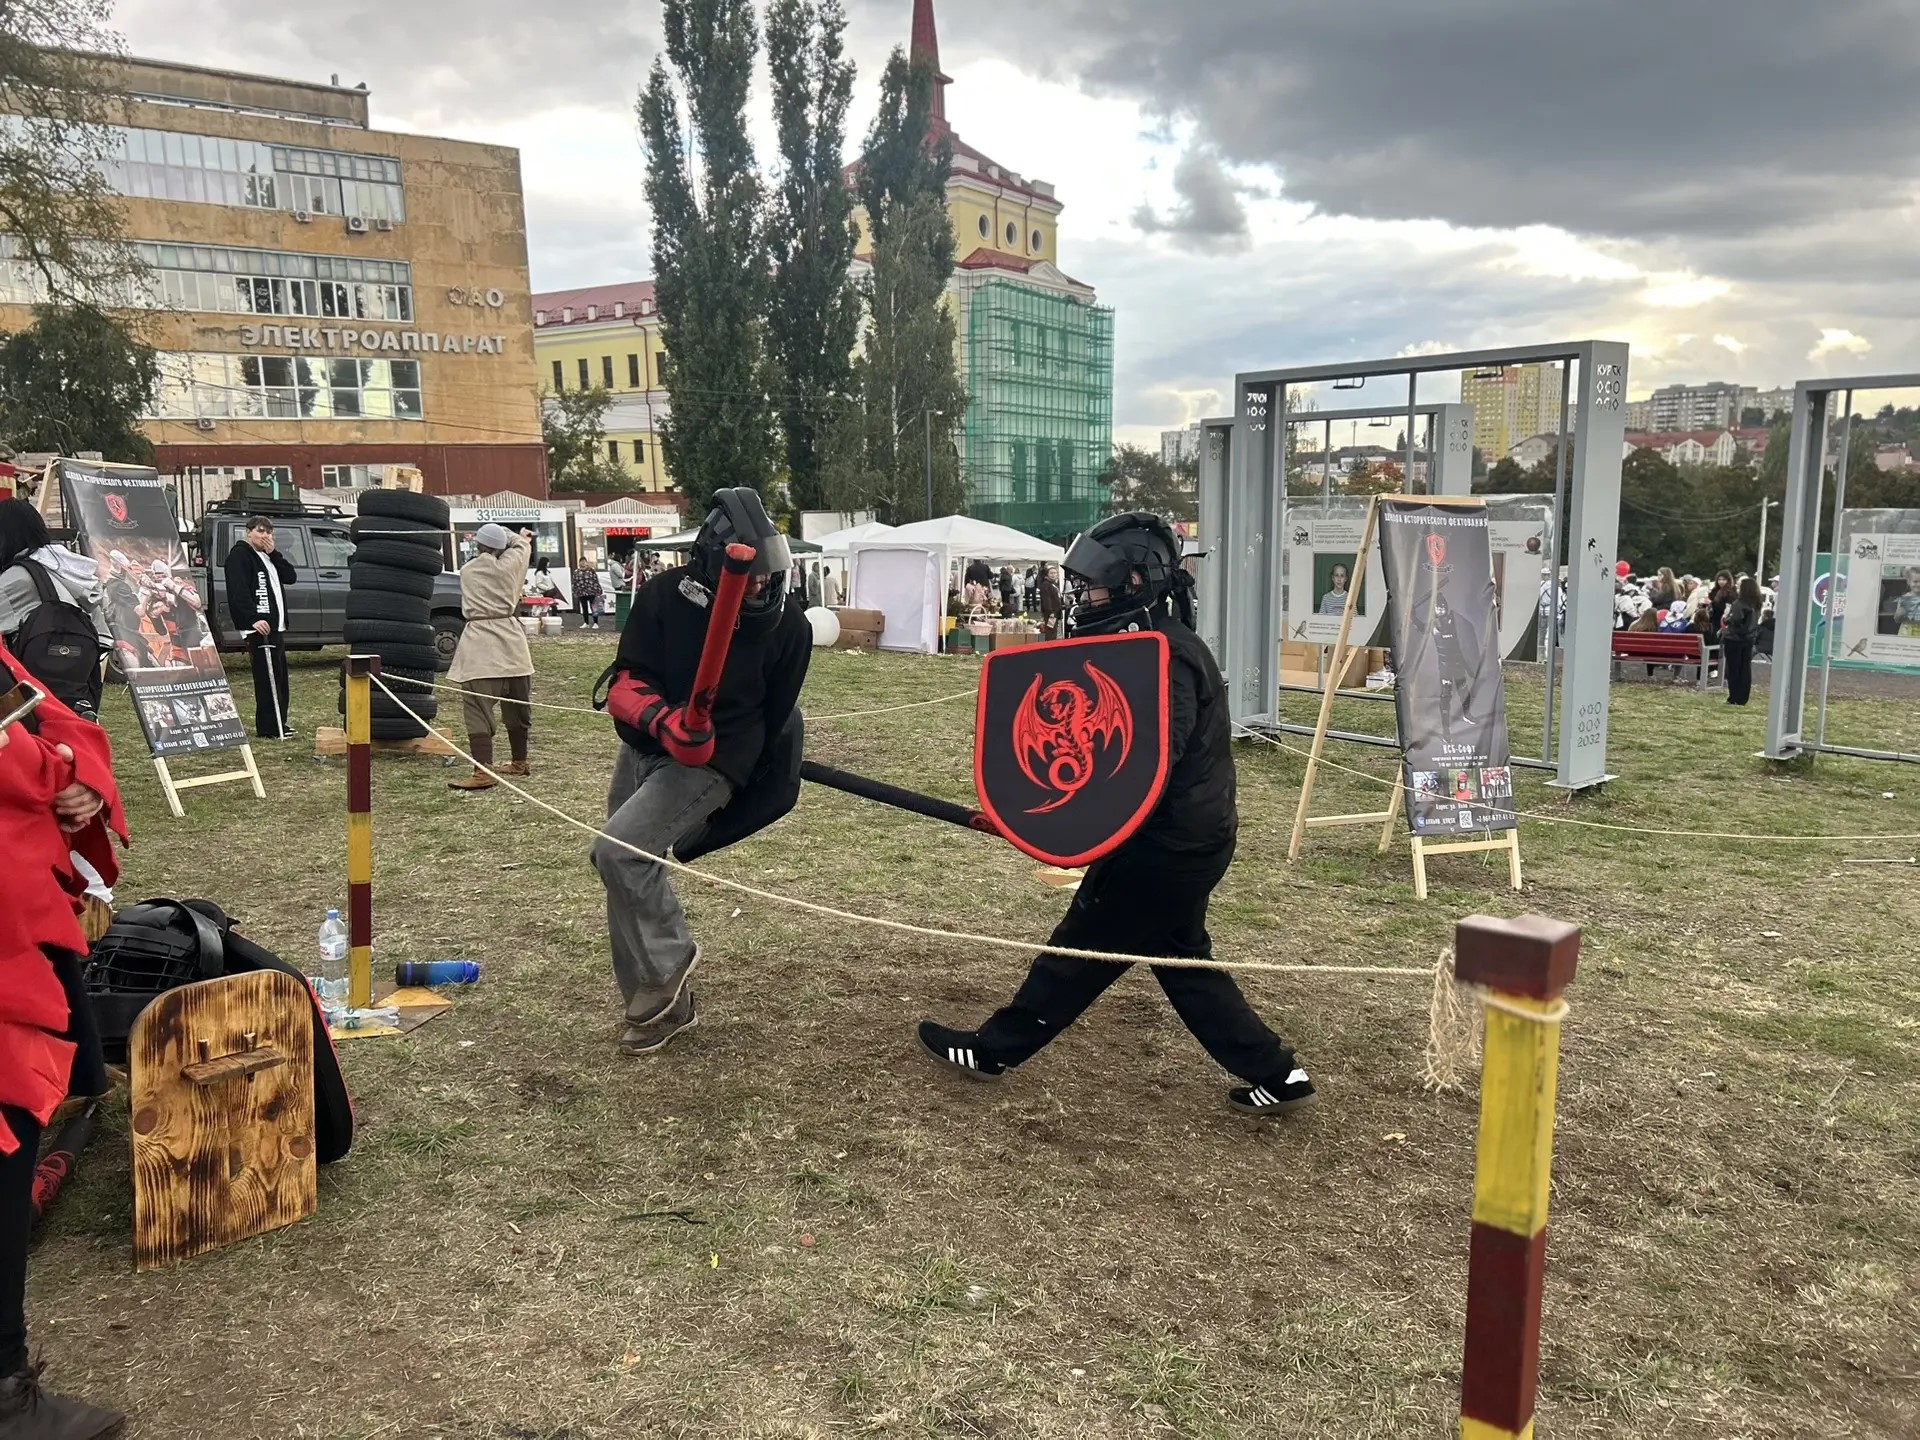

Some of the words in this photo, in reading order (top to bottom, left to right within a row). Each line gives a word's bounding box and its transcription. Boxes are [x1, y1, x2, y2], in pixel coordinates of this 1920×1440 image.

[240, 325, 506, 354] ЭЛЕКТРОАППАРАТ
[476, 509, 491, 521] 33
[491, 509, 541, 517] пингвина
[1403, 514, 1447, 526] ИСТОРИЧЕСКОГО
[1448, 517, 1488, 527] ФЕХТОВАНИЯ
[606, 527, 630, 536] ВАТА
[255, 571, 270, 613] Marlboro
[1577, 732, 1600, 748] 2032
